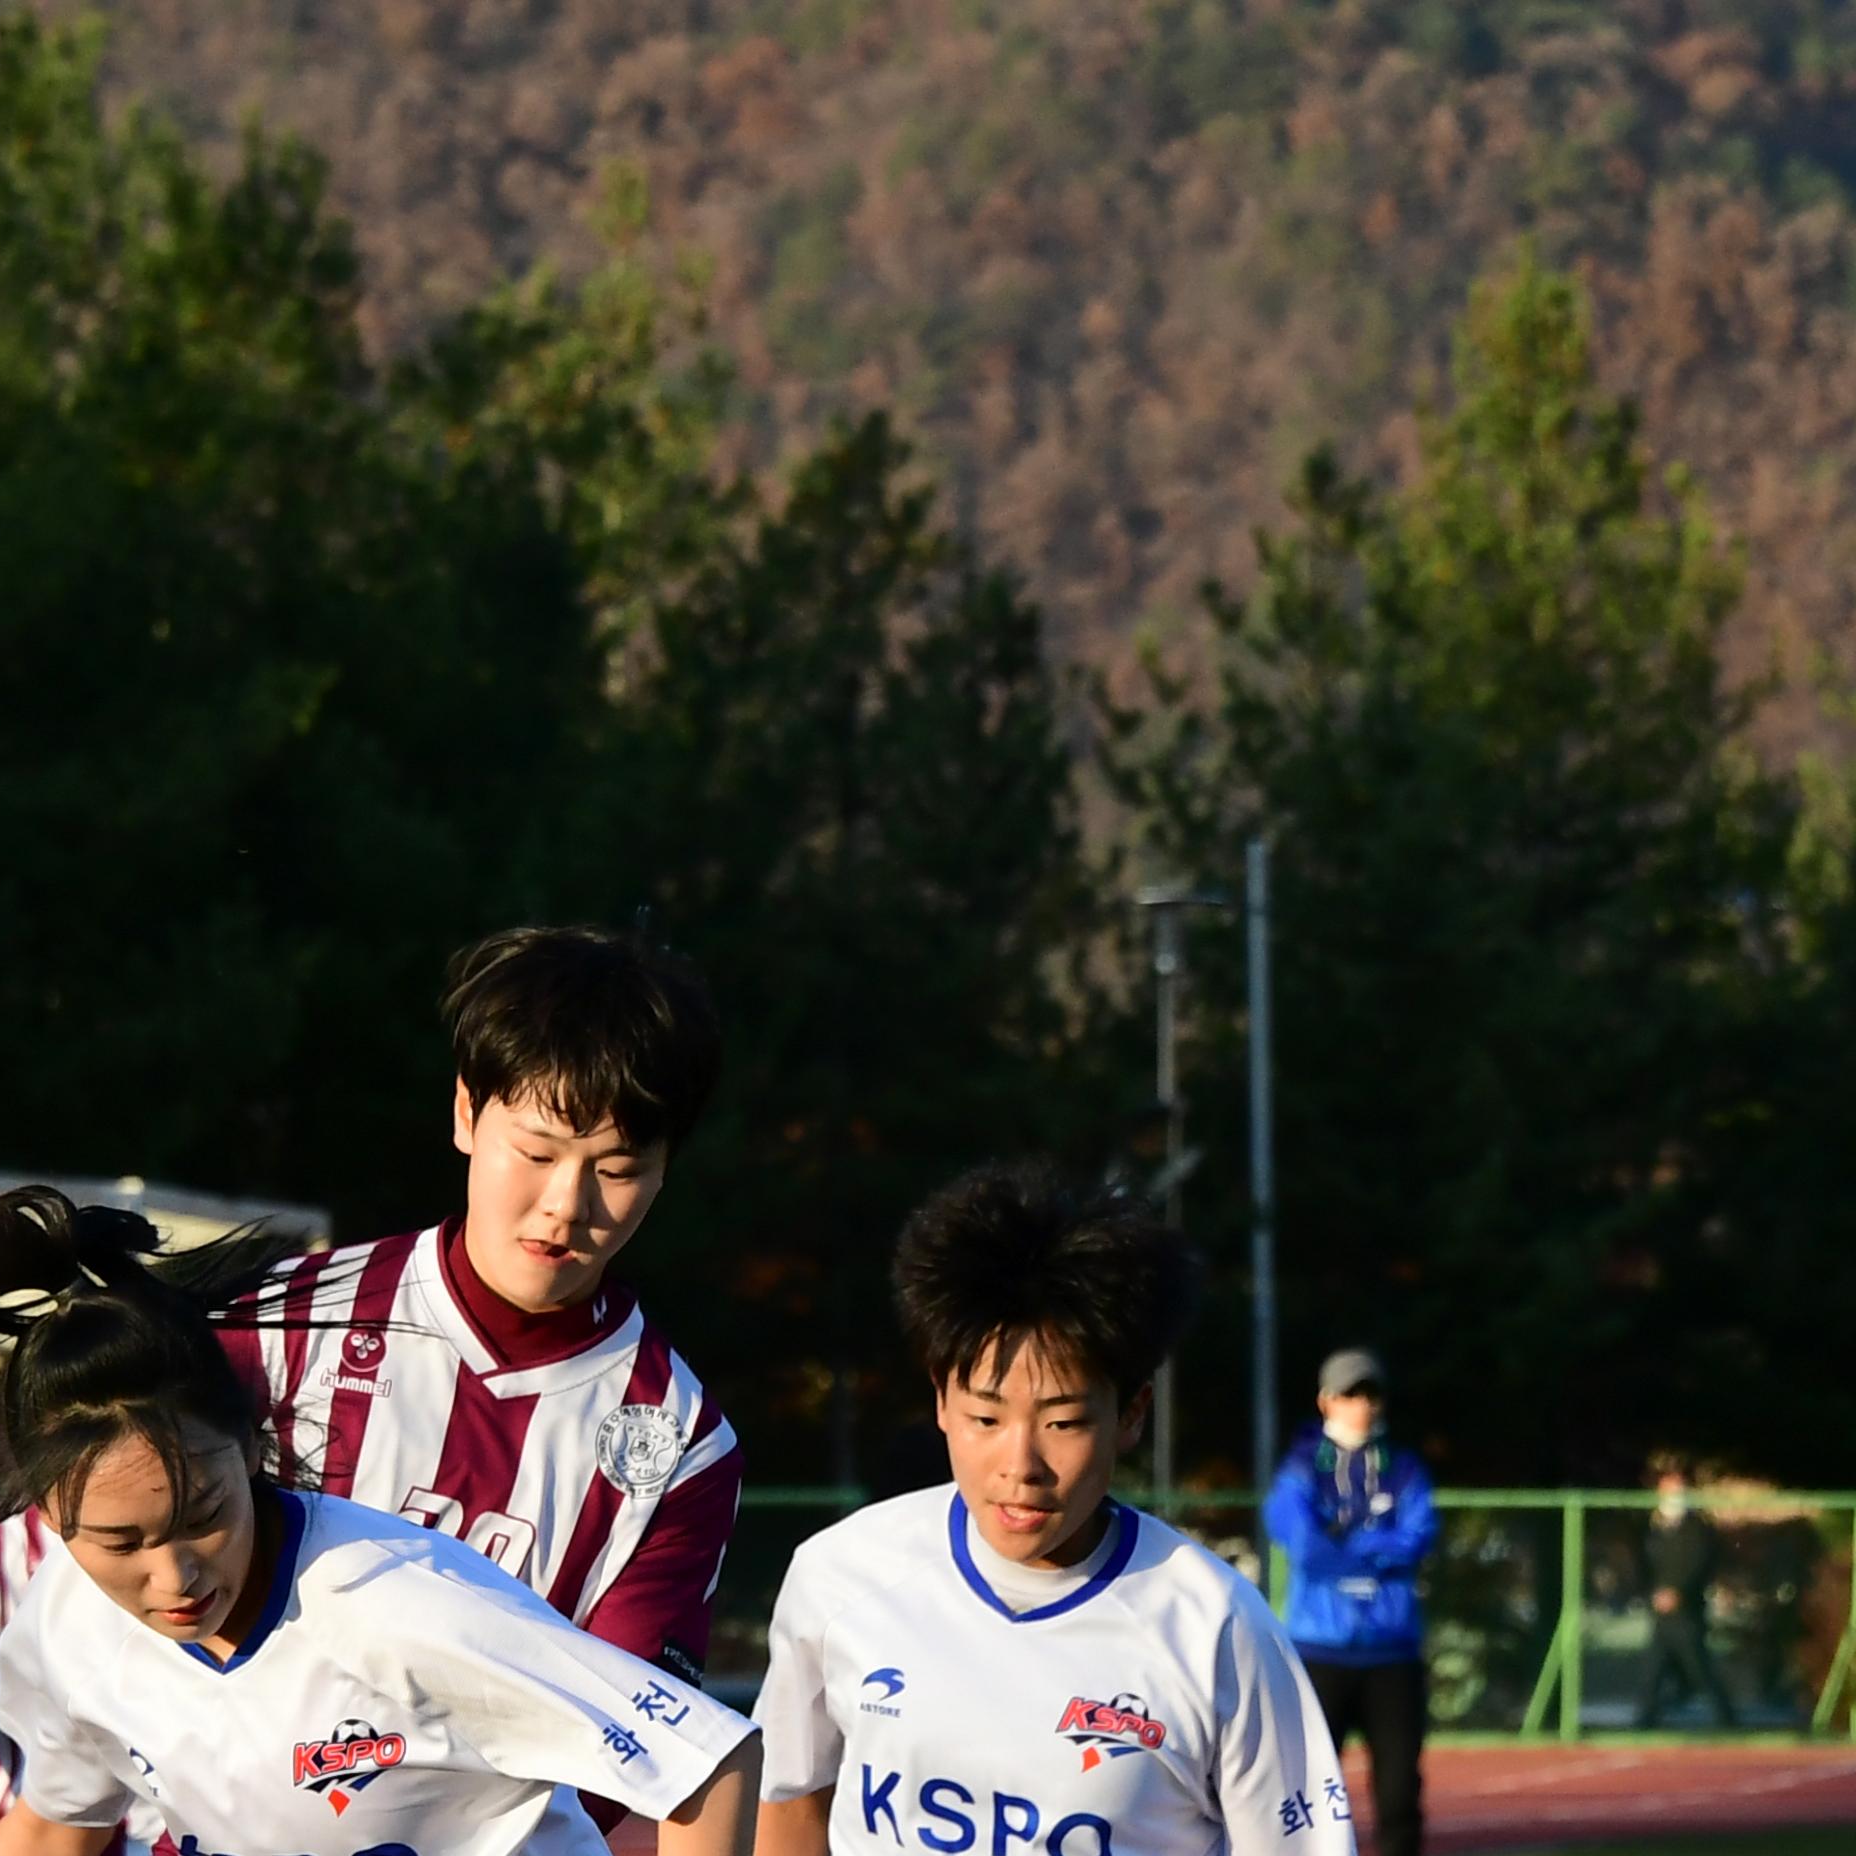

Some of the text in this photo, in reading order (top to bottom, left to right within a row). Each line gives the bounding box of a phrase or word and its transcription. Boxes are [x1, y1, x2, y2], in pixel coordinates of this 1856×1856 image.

[320, 1367, 393, 1398] hummel
[1055, 1696, 1166, 1750] KSPO
[293, 1732, 407, 1787] KSPO
